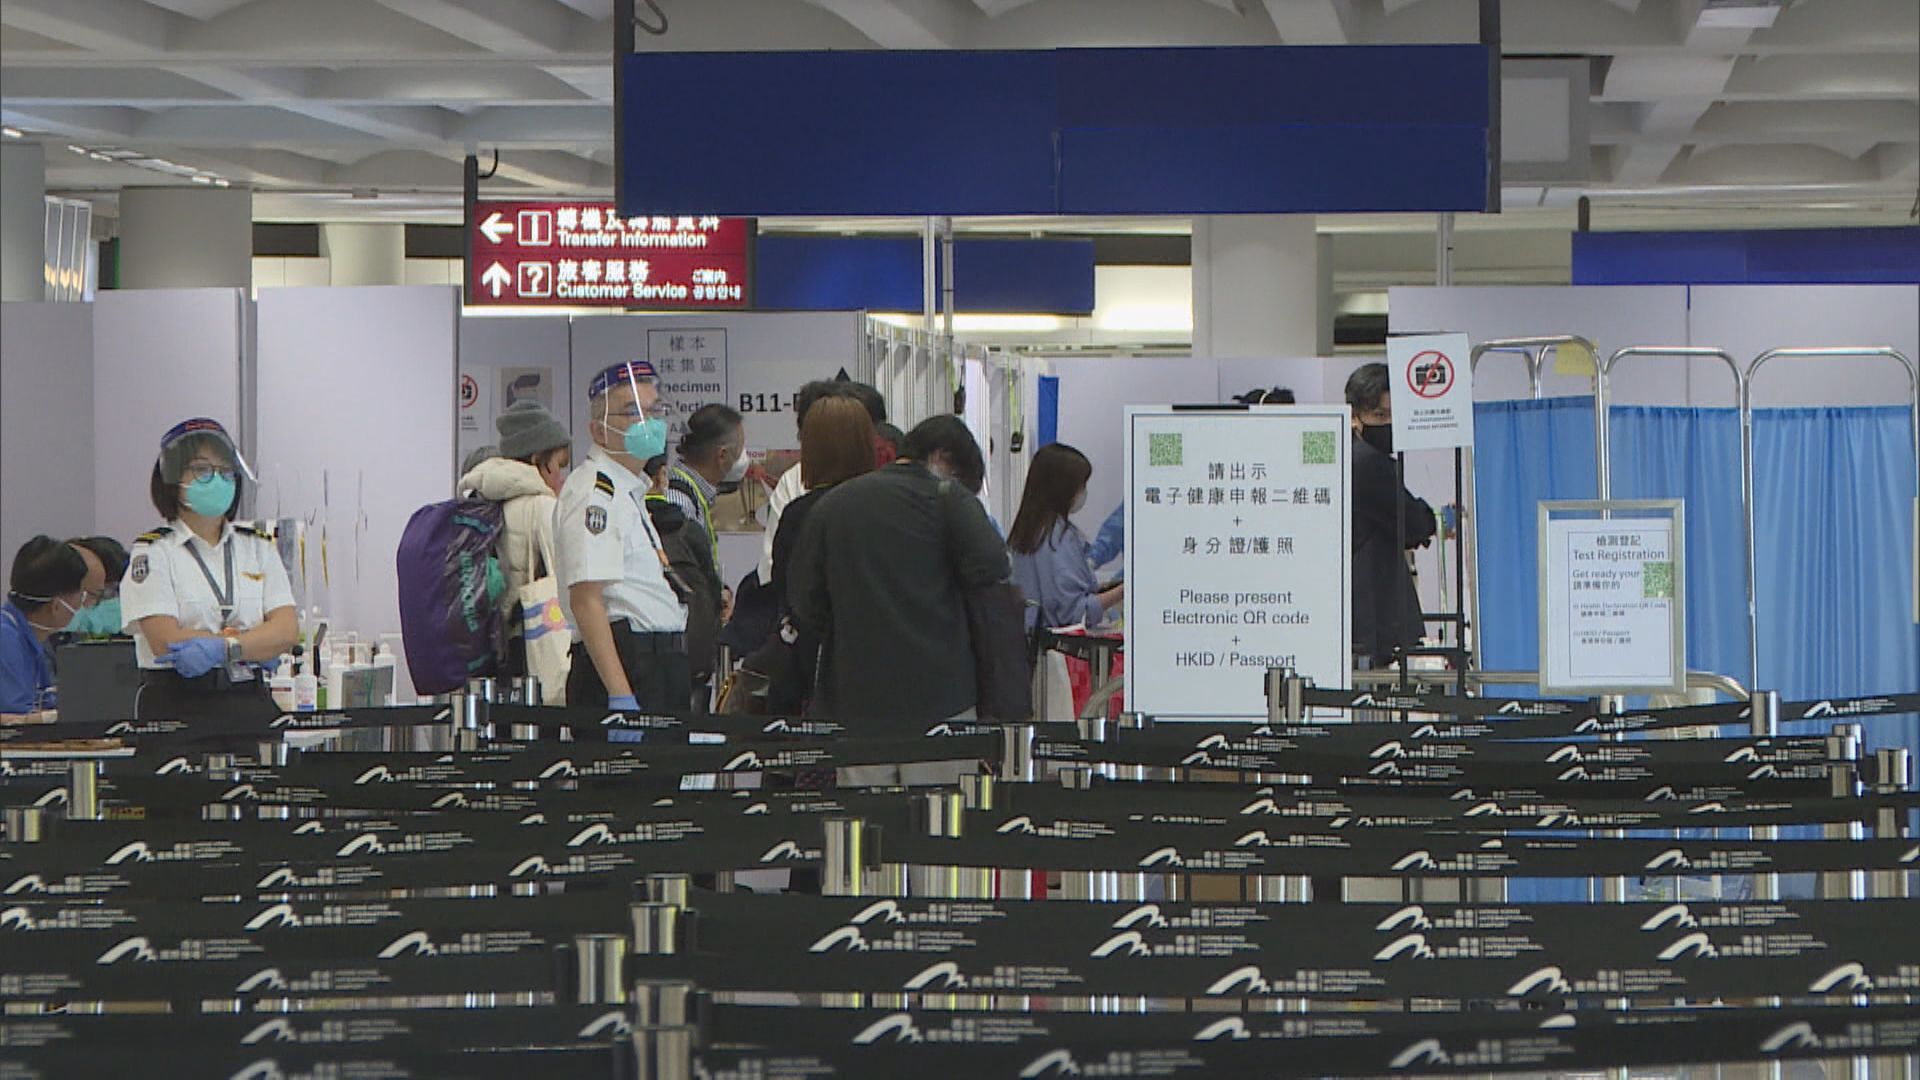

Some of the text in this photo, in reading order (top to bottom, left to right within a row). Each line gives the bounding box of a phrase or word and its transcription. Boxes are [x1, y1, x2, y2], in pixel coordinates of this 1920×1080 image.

[557, 230, 707, 247] Transfer Information
[557, 258, 650, 282] 旅客服務
[557, 283, 687, 299] Customer Service
[670, 335, 705, 352] 樣本
[660, 357, 717, 374] 採集區
[1208, 462, 1267, 481] 請出示
[1144, 487, 1332, 505] 電子健康申報二維碼
[1574, 549, 1665, 562] Test Registration
[1572, 569, 1640, 580] Get ready your
[1180, 589, 1293, 608] Please present
[1162, 610, 1310, 626] Electronic QR code
[1176, 652, 1215, 666] HKID
[1230, 652, 1297, 668] Passport
